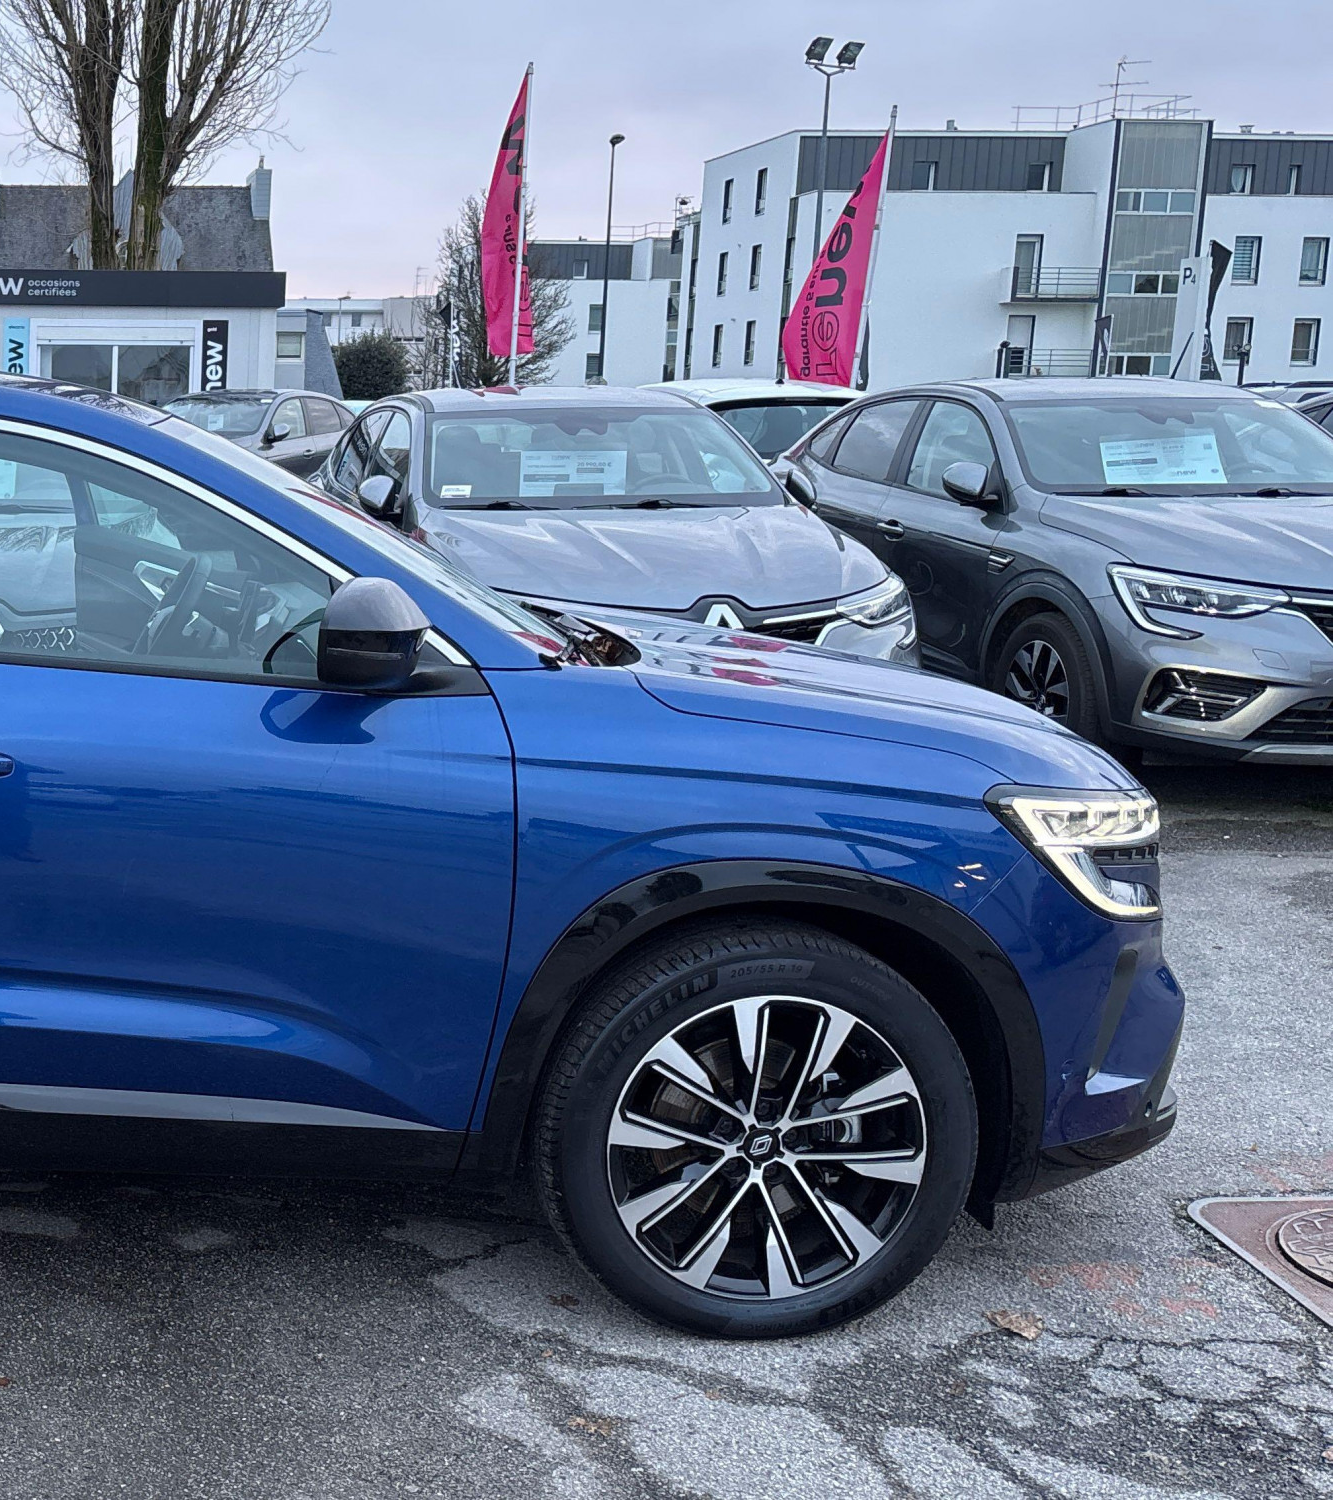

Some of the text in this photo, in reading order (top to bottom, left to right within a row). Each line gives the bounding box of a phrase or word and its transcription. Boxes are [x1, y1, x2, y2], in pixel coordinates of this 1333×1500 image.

[27, 278, 81, 288] occasions
[27, 287, 77, 297] certifiées
[730, 964, 774, 979] 205/55
[778, 965, 786, 973] R
[596, 973, 710, 1073] MICHELIN
